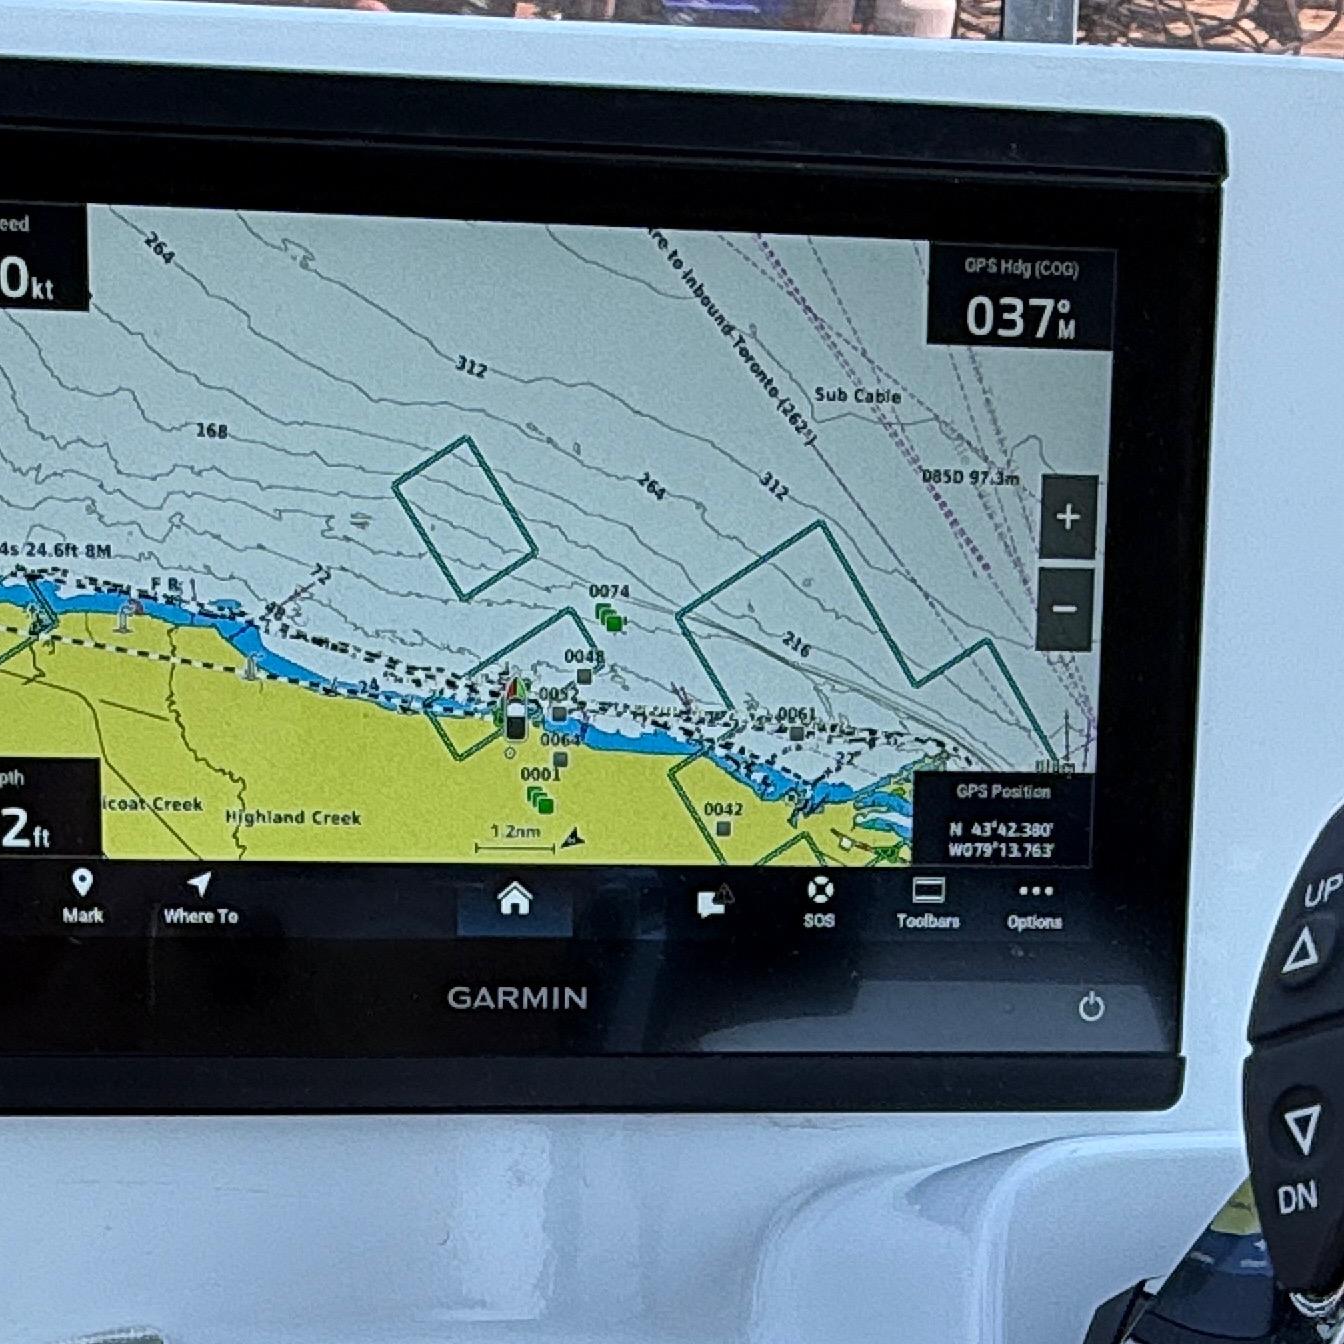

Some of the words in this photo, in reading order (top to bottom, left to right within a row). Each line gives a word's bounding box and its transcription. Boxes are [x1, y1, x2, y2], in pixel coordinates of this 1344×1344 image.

[144, 231, 175, 263] 264
[965, 257, 997, 273] GPS
[1001, 259, 1031, 279] Hdg
[1035, 260, 1080, 281] (COG)
[31, 277, 54, 299] kt
[681, 268, 736, 336] Inbound
[732, 334, 778, 398] Toronto
[456, 355, 487, 378] 312
[815, 386, 847, 402] Sub
[855, 388, 902, 404] Cable
[196, 423, 228, 439] 168
[638, 471, 666, 500] 264
[759, 471, 789, 501] 312
[86, 544, 112, 558] 8M
[589, 585, 630, 597] 0074
[783, 631, 812, 658] 216
[521, 767, 561, 781] 0001
[956, 784, 988, 799] GPS
[991, 784, 1052, 800] Position
[153, 797, 203, 812] Creek
[704, 802, 743, 816] 0042
[226, 809, 305, 827] Highland
[312, 811, 362, 826] Creek
[33, 826, 50, 848] ft
[1304, 873, 1344, 908] UP
[62, 907, 104, 924] Mark
[164, 908, 214, 924] Where
[217, 908, 239, 924] To
[803, 913, 836, 928] SOS
[896, 913, 960, 929] Toolbars
[1006, 914, 1063, 931] Options
[446, 986, 588, 1010] GARMIN
[1278, 1180, 1318, 1215] DN
